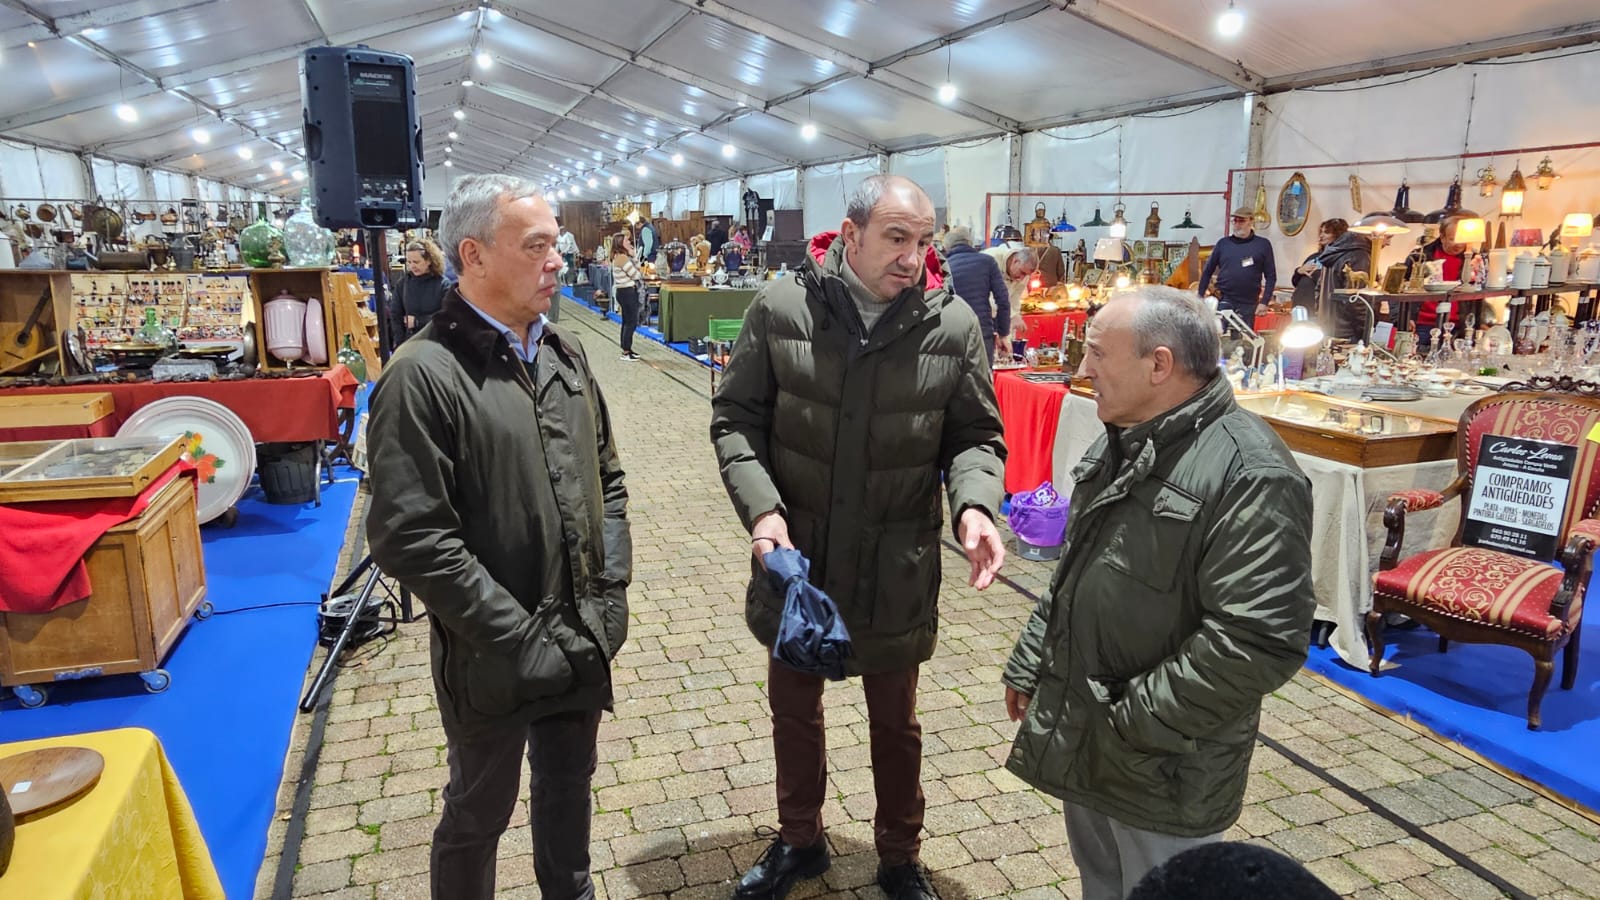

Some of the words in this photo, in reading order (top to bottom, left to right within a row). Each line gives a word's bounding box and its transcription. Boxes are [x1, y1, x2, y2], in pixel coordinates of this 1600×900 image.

[1489, 441, 1528, 456] Carlos
[1488, 472, 1552, 495] COMPRAMOS
[1472, 507, 1495, 519] PINTURA
[1495, 512, 1517, 523] GALLEGA
[1483, 502, 1499, 512] PLATA
[1522, 509, 1548, 521] MONEDAS
